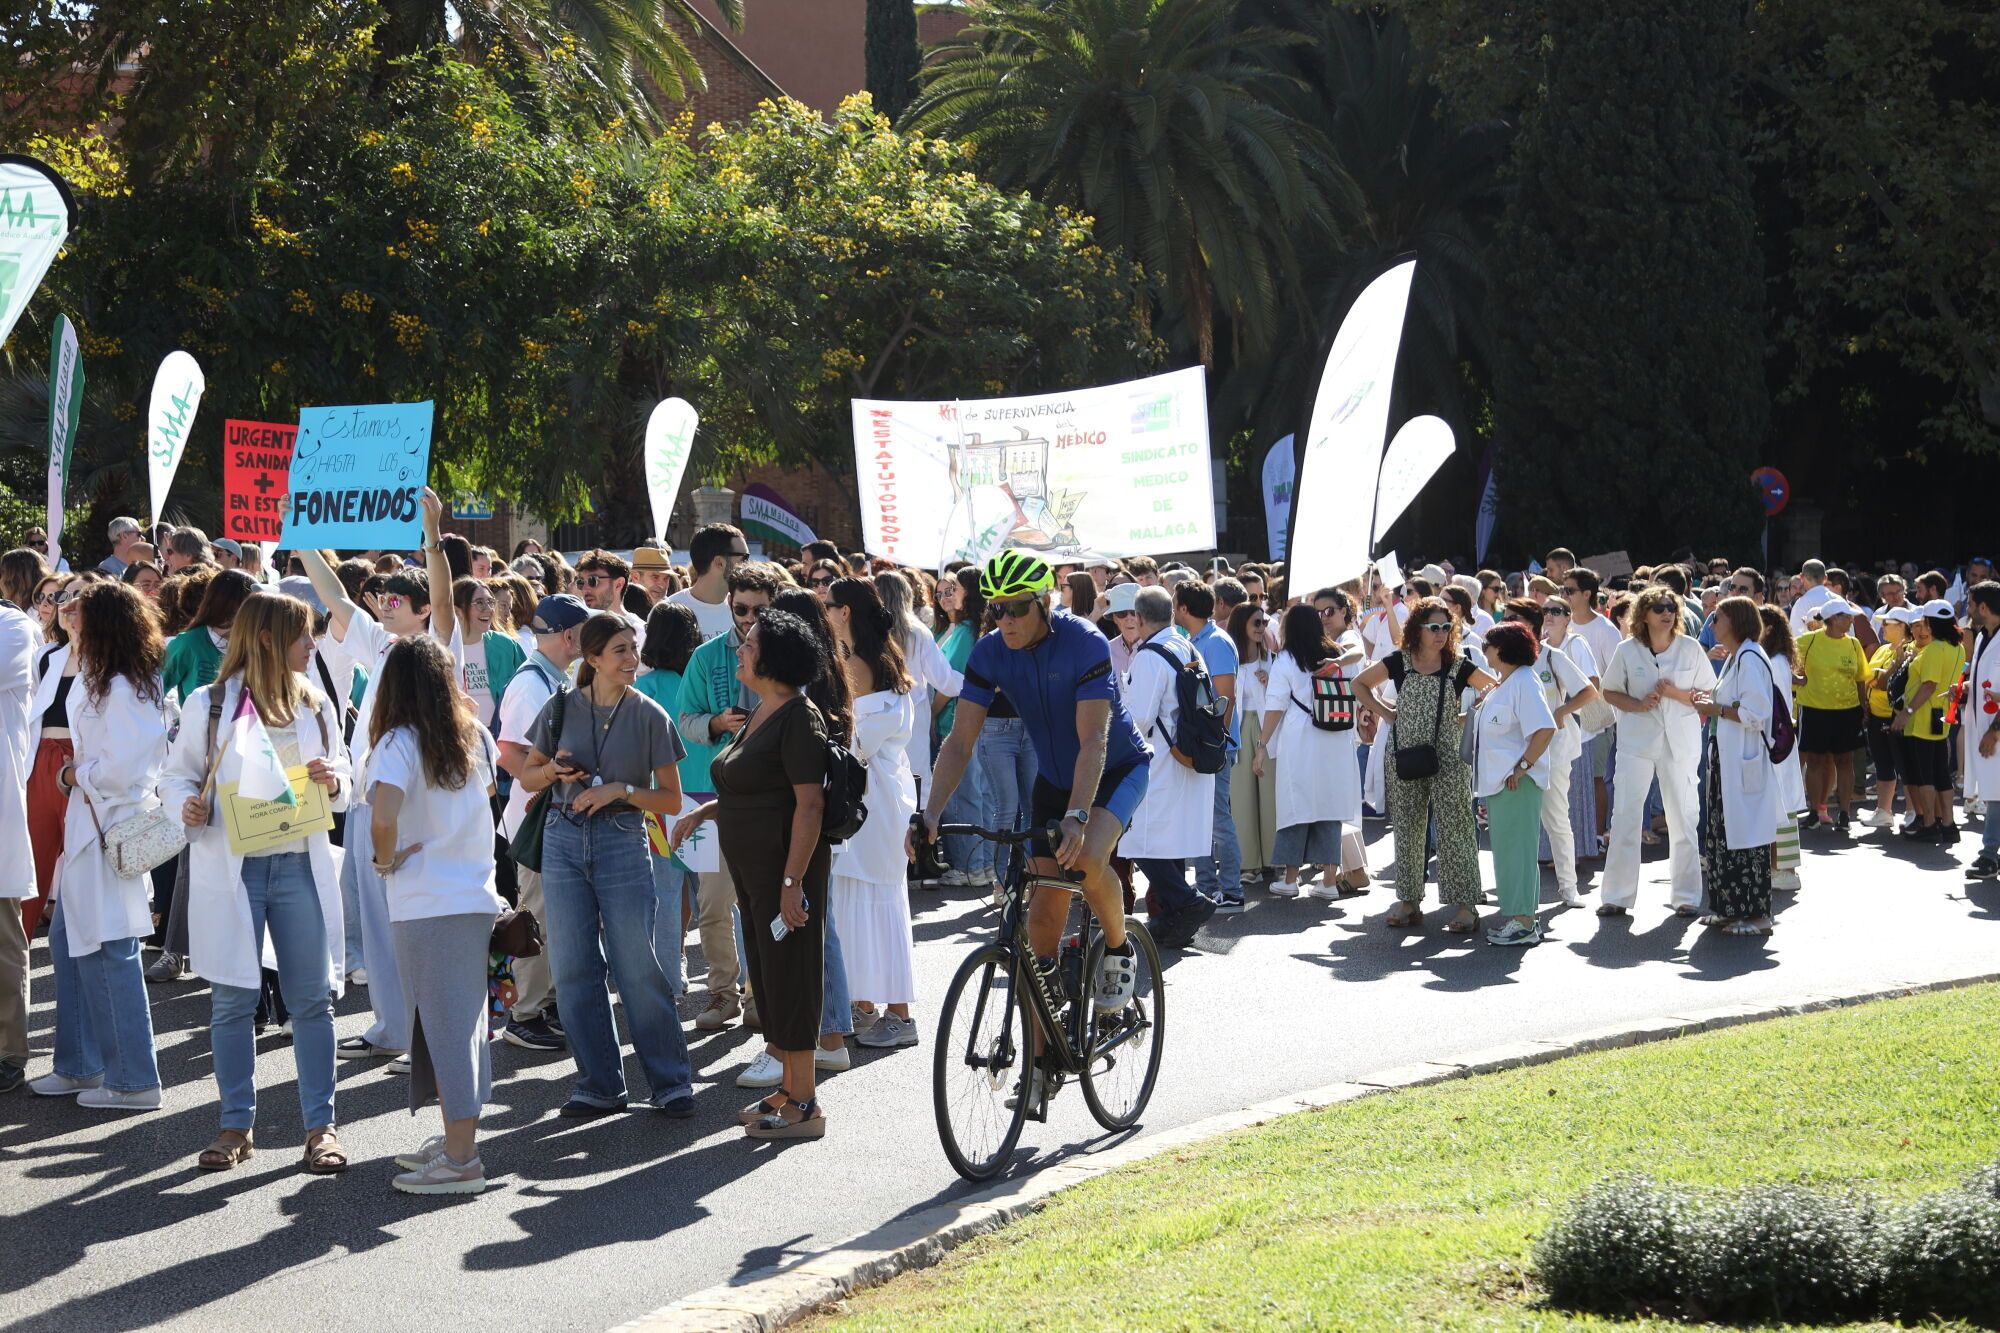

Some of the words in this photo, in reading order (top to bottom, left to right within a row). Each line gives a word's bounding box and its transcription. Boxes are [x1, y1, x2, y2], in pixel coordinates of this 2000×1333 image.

[985, 401, 1077, 421] SUPERVIVENCIA
[321, 408, 401, 440] Estamos
[229, 427, 296, 448] URGENT
[235, 452, 292, 470] SANIDA
[318, 454, 356, 473] HASTA
[379, 452, 398, 472] LOS
[1120, 442, 1200, 464] SINDICATO
[230, 494, 249, 511] EN
[255, 496, 280, 512] EST
[292, 487, 417, 526] FONENDOS
[1152, 498, 1173, 512] DE
[249, 810, 268, 820] HORA
[250, 800, 269, 811] HORA
